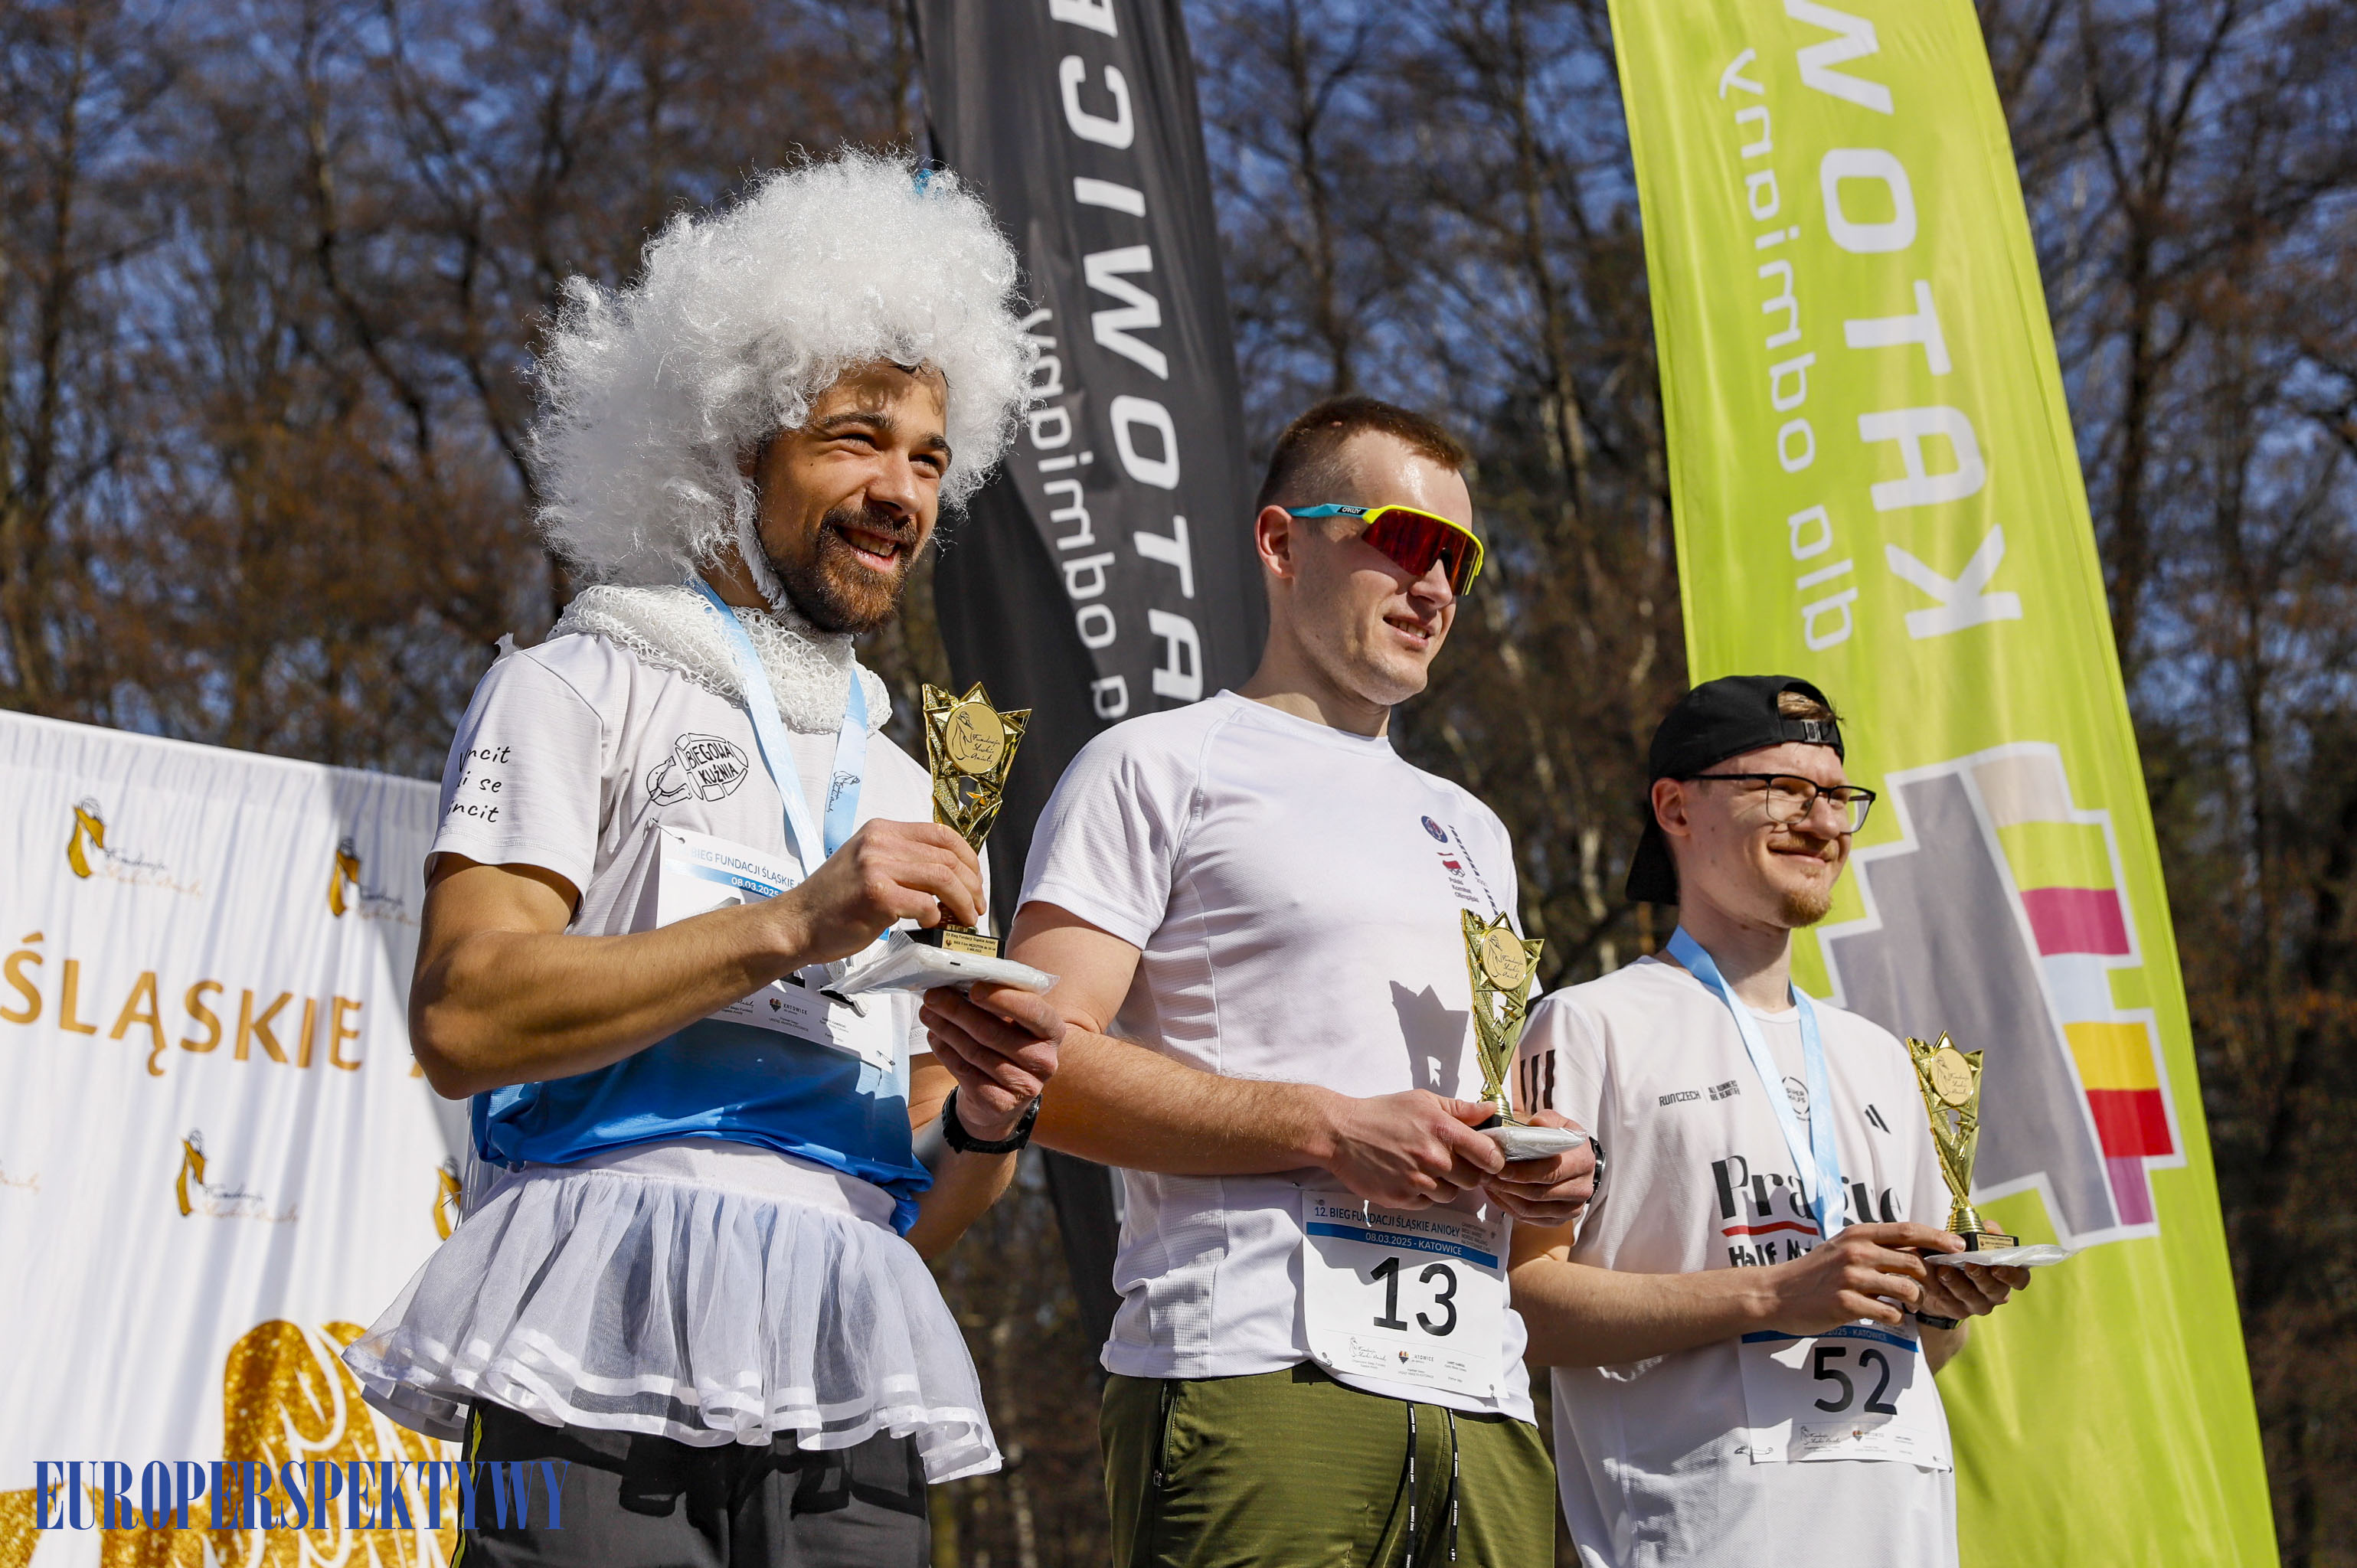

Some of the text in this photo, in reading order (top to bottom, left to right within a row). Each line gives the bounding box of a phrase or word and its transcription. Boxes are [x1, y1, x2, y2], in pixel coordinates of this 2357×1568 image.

[459, 746, 511, 773] Vncit
[686, 743, 734, 769] BIEGOWA
[479, 778, 502, 793] se
[446, 800, 499, 823] incit
[691, 848, 713, 862] BIEG
[714, 854, 760, 875] FUNDACJI
[761, 866, 795, 888] ŚLĄSKIE
[731, 877, 780, 897] 08.03.2025
[0, 932, 365, 1076] ŚLĄSKIE
[1659, 1090, 1702, 1107] RUNCZECH
[1315, 1207, 1460, 1238] 12. BIEG FUNDACJI ŚLĄSKIE ANIOŁY
[1365, 1232, 1412, 1247] 08.03.2025
[1418, 1240, 1462, 1256] KATOWICE
[1370, 1256, 1457, 1337] 13
[1413, 1354, 1434, 1362] ATOWICE
[1813, 1347, 1898, 1415] 52
